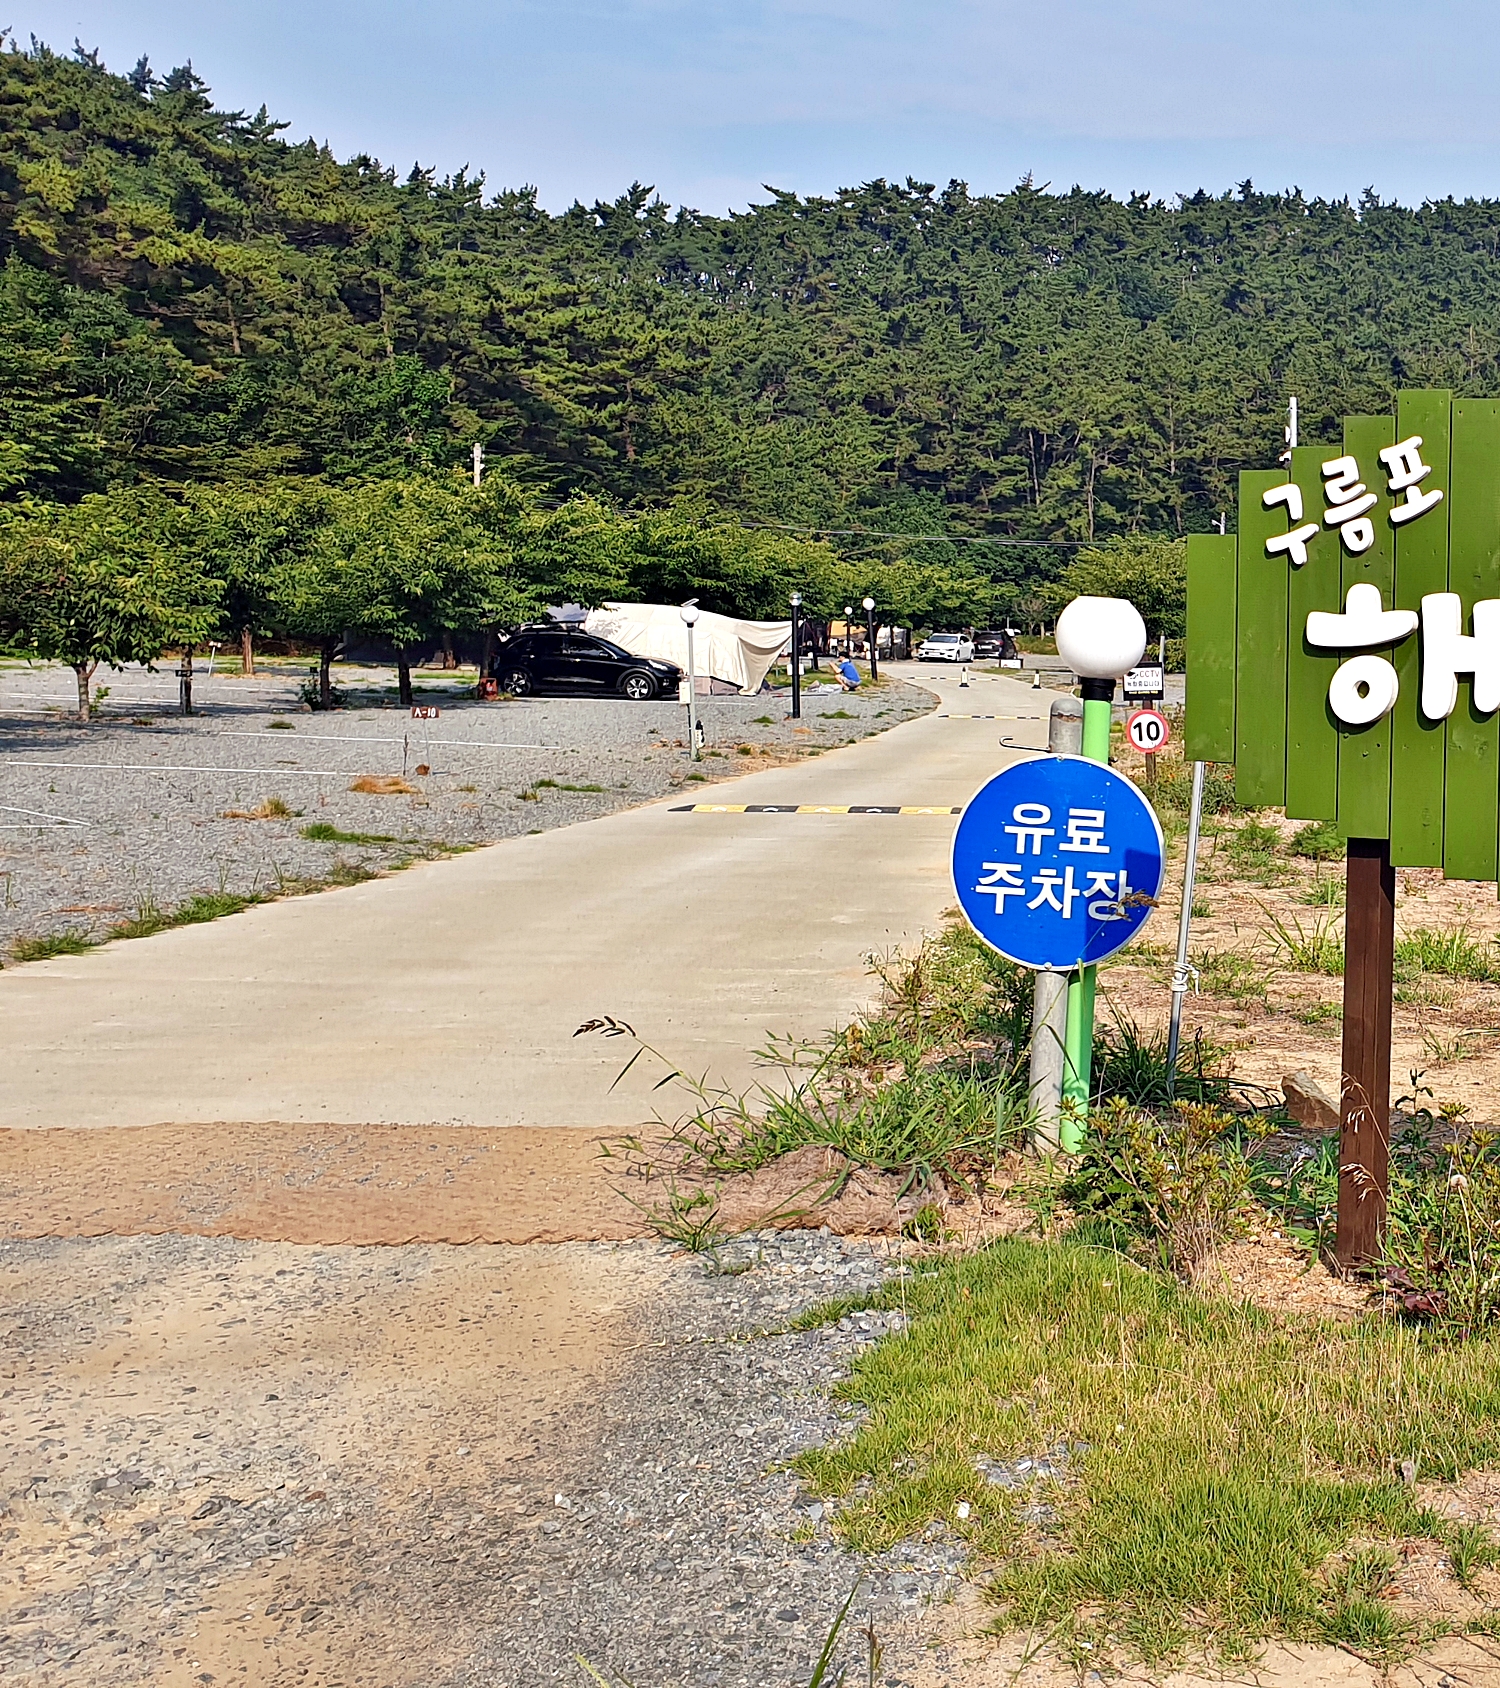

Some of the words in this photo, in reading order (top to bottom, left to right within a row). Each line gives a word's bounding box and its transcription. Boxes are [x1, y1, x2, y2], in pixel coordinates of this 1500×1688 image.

[1262, 435, 1444, 566] 구름포
[1139, 670, 1160, 678] CCTV
[414, 707, 436, 718] A-10
[1133, 720, 1160, 742] 10
[1004, 803, 1111, 856] 유료
[975, 862, 1134, 921] 주차장
